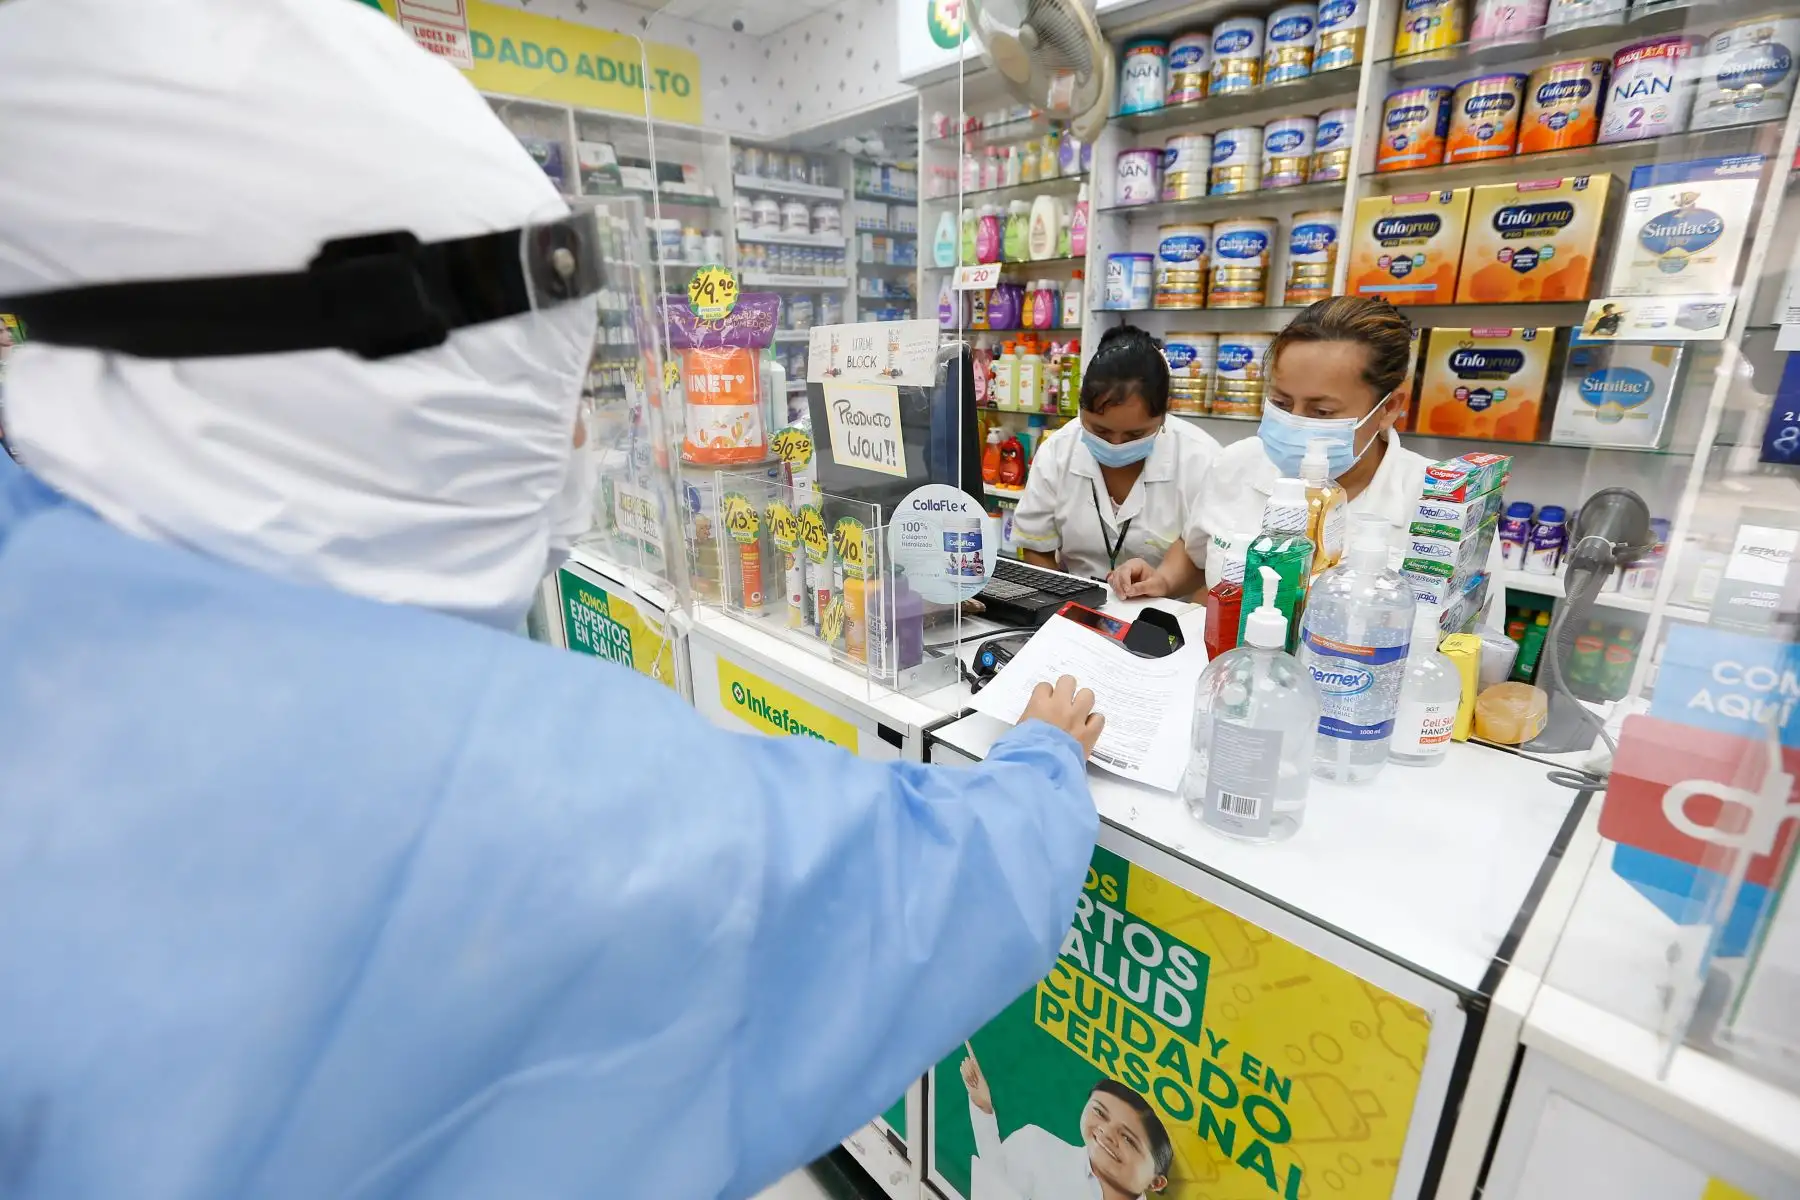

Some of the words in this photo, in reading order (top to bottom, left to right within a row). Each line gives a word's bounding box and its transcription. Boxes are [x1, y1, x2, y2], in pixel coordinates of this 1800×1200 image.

[471, 30, 569, 74] DADO
[575, 53, 691, 97] ADULTO
[1126, 65, 1160, 80] NAN
[1613, 76, 1673, 101] NAN
[1626, 107, 1646, 129] 2
[1124, 186, 1132, 199] 2
[1498, 208, 1572, 227] Enfagrow
[1377, 219, 1440, 237] Enfagrow
[1219, 237, 1263, 252] BabyLac
[973, 270, 989, 282] 20
[846, 355, 878, 368] BLOCK
[1454, 353, 1520, 369] Enfagrow
[1430, 469, 1461, 479] Colgate
[913, 499, 968, 513] CollaFlex
[901, 521, 928, 533] 100%
[579, 589, 609, 617] SOMOS
[570, 598, 630, 651] EXPERTOS
[574, 620, 590, 647] EN
[747, 687, 837, 746] Inkafar
[1422, 718, 1441, 728] Cell
[1420, 727, 1444, 736] HAND
[1045, 964, 1292, 1145] CUIDADO
[1205, 1027, 1230, 1059] Y
[1240, 1051, 1292, 1105] EN
